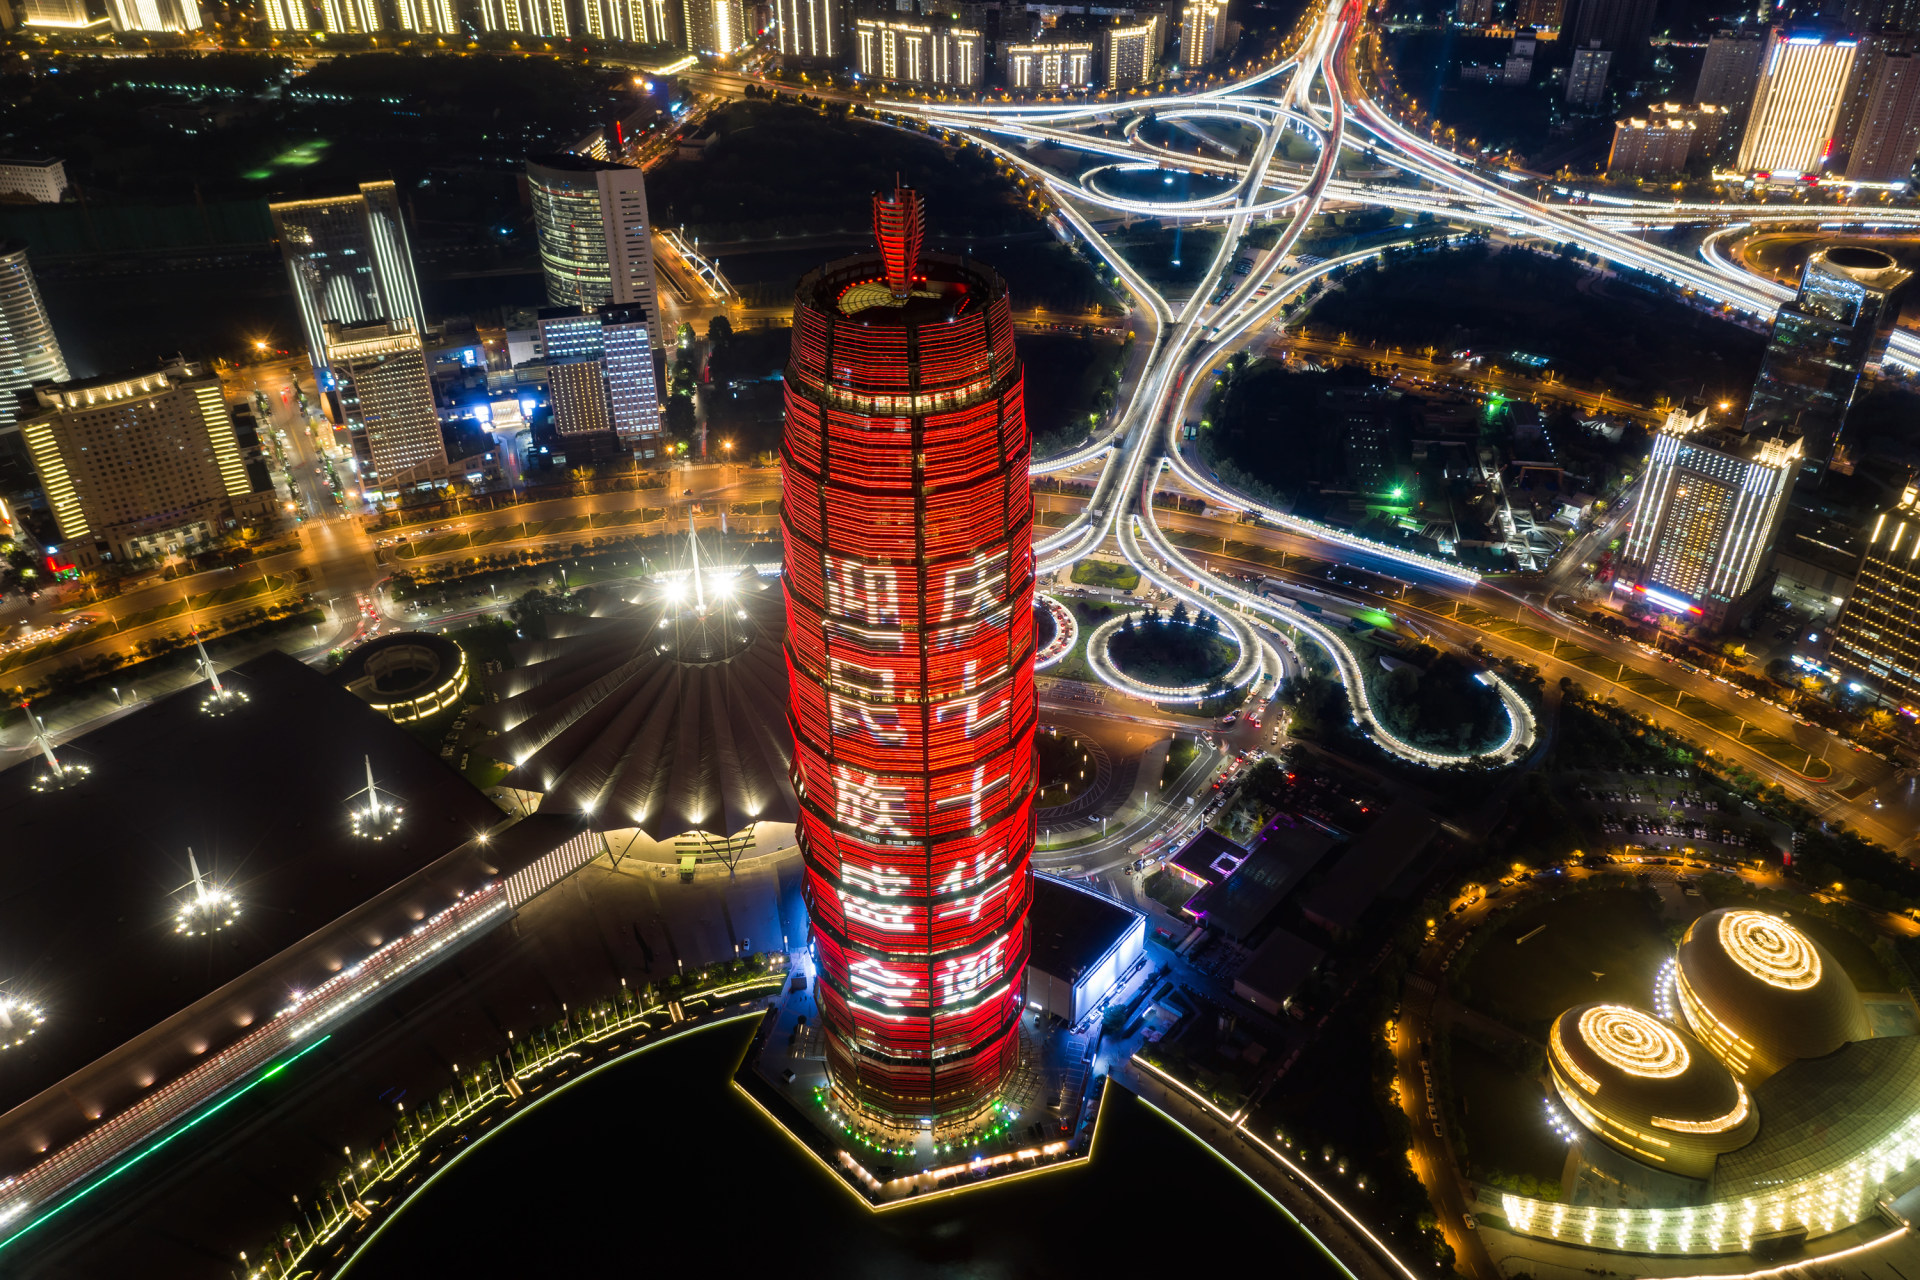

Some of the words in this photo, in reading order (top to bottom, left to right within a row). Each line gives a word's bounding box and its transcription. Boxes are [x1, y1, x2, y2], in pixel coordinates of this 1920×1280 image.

[823, 554, 917, 1022] 迎民族盛会
[934, 550, 1013, 1017] 庆七十华诞
